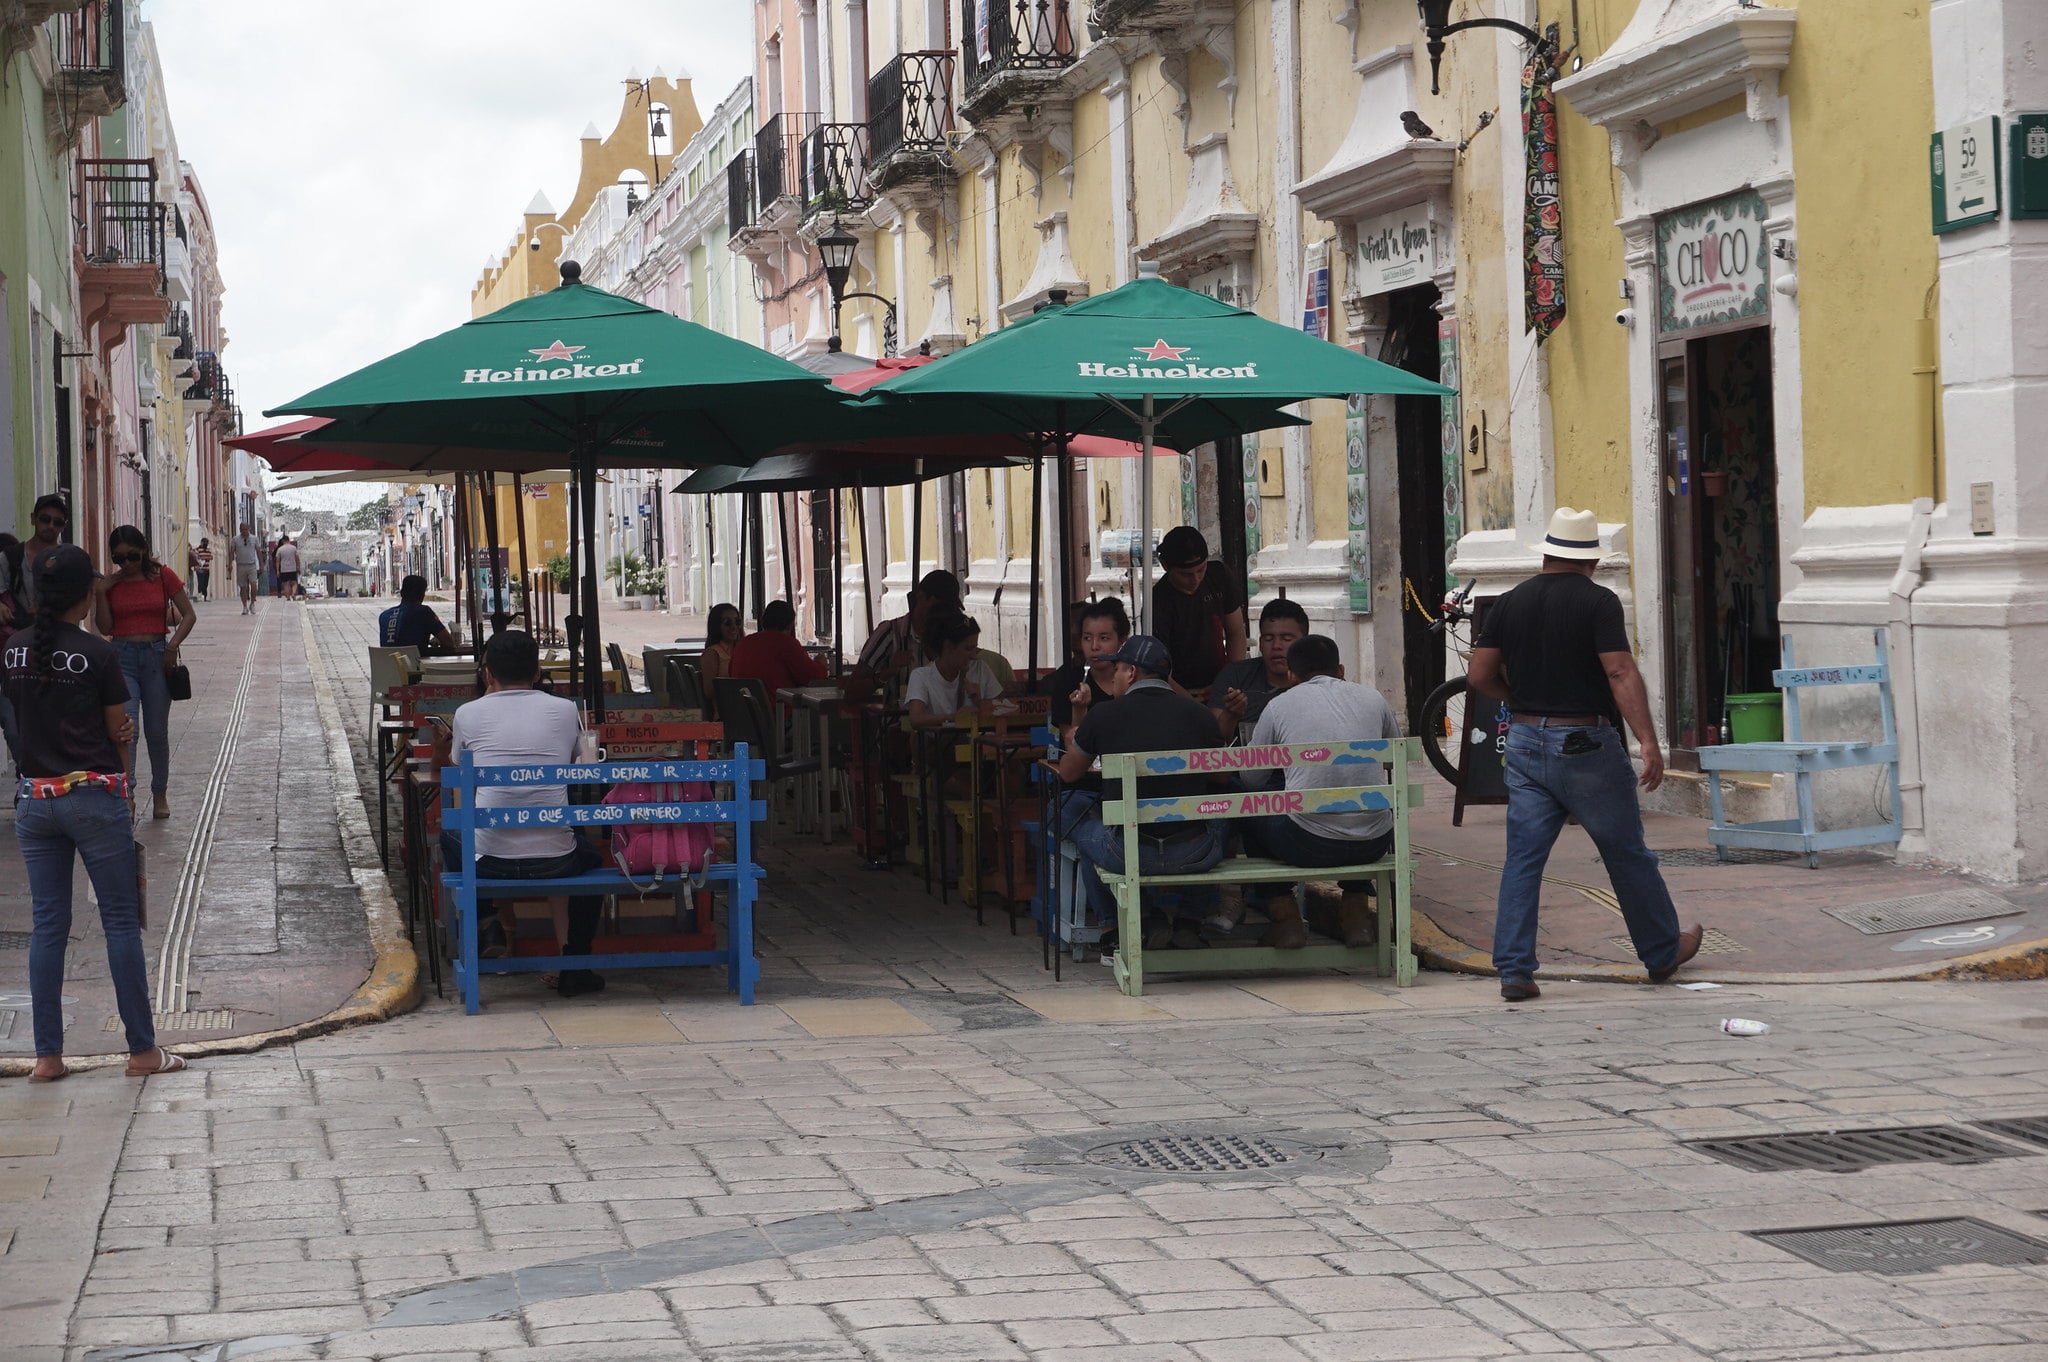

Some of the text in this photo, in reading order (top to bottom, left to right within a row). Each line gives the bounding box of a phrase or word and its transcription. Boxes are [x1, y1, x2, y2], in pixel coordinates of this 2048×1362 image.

[1961, 137, 1976, 169] 59
[461, 362, 642, 384] Heineken
[1078, 362, 1259, 379] Heineken
[626, 727, 659, 738] MISMO
[1189, 746, 1293, 771] DESAYUNOS
[556, 767, 600, 779] PUEDAS
[612, 767, 650, 781] DEJAR
[663, 765, 679, 778] IR
[1239, 791, 1304, 815] AMOR
[518, 811, 529, 823] LO
[539, 808, 563, 822] QUE
[574, 810, 589, 821] TE
[630, 807, 681, 821] PRIMERO
